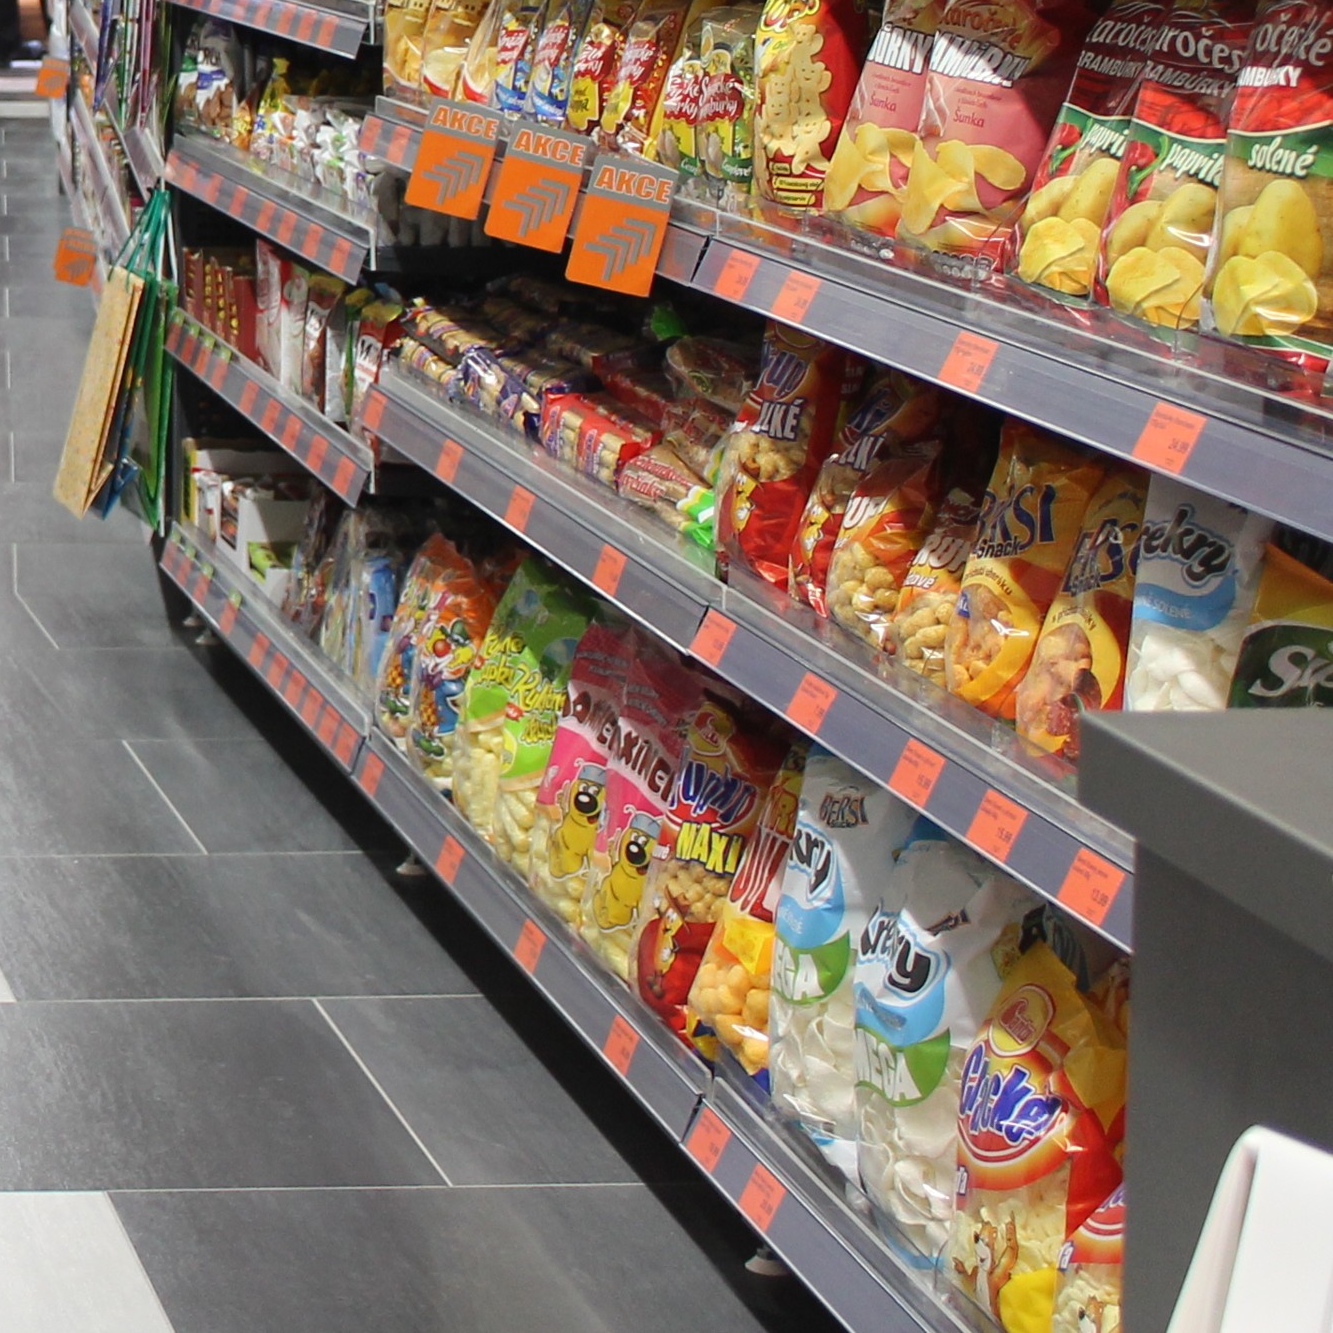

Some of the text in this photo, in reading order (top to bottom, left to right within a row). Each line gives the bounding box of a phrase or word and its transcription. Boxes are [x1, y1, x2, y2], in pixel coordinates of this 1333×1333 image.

[869, 93, 897, 114] Šunka
[953, 105, 984, 127] Šunka
[431, 105, 499, 141] AKCE
[512, 130, 586, 167] AKCE
[1248, 136, 1320, 177] solené
[595, 165, 674, 204] AKCE
